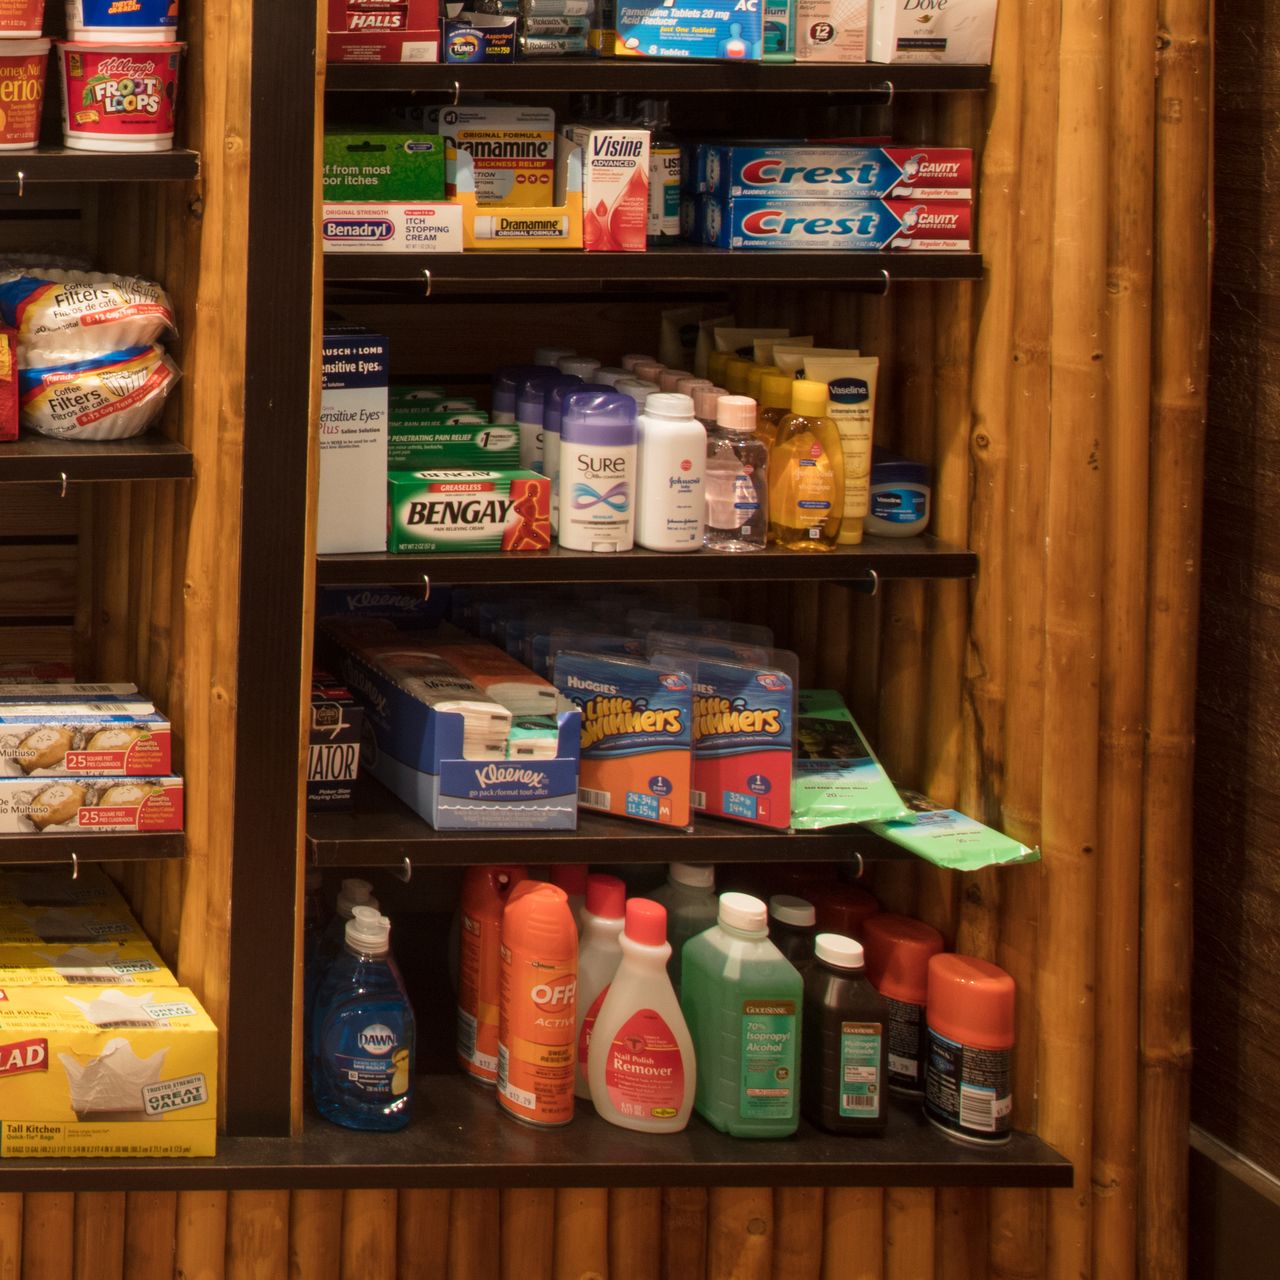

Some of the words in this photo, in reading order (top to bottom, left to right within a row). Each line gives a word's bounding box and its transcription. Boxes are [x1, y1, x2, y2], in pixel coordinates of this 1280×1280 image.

[453, 44, 476, 54] TUMS
[649, 45, 657, 55] 8
[659, 46, 690, 55] Tablets
[594, 135, 643, 159] Visine
[593, 159, 635, 168] ADVANCED
[919, 162, 958, 173] CAVITY
[741, 157, 879, 187] Crest
[324, 222, 391, 241] Benadryl
[406, 226, 449, 234] STOPPING
[499, 219, 560, 232] Dramamine
[440, 483, 482, 492] GREASELESS
[407, 499, 516, 526] BENGAY
[68, 755, 86, 768] 25
[474, 765, 546, 790] Kleenex
[358, 1031, 396, 1048] DAWN
[746, 1042, 784, 1053] Alcohol
[613, 1058, 673, 1077] Remover
[7, 1125, 23, 1134] Tall
[26, 1124, 60, 1135] Kitchen
